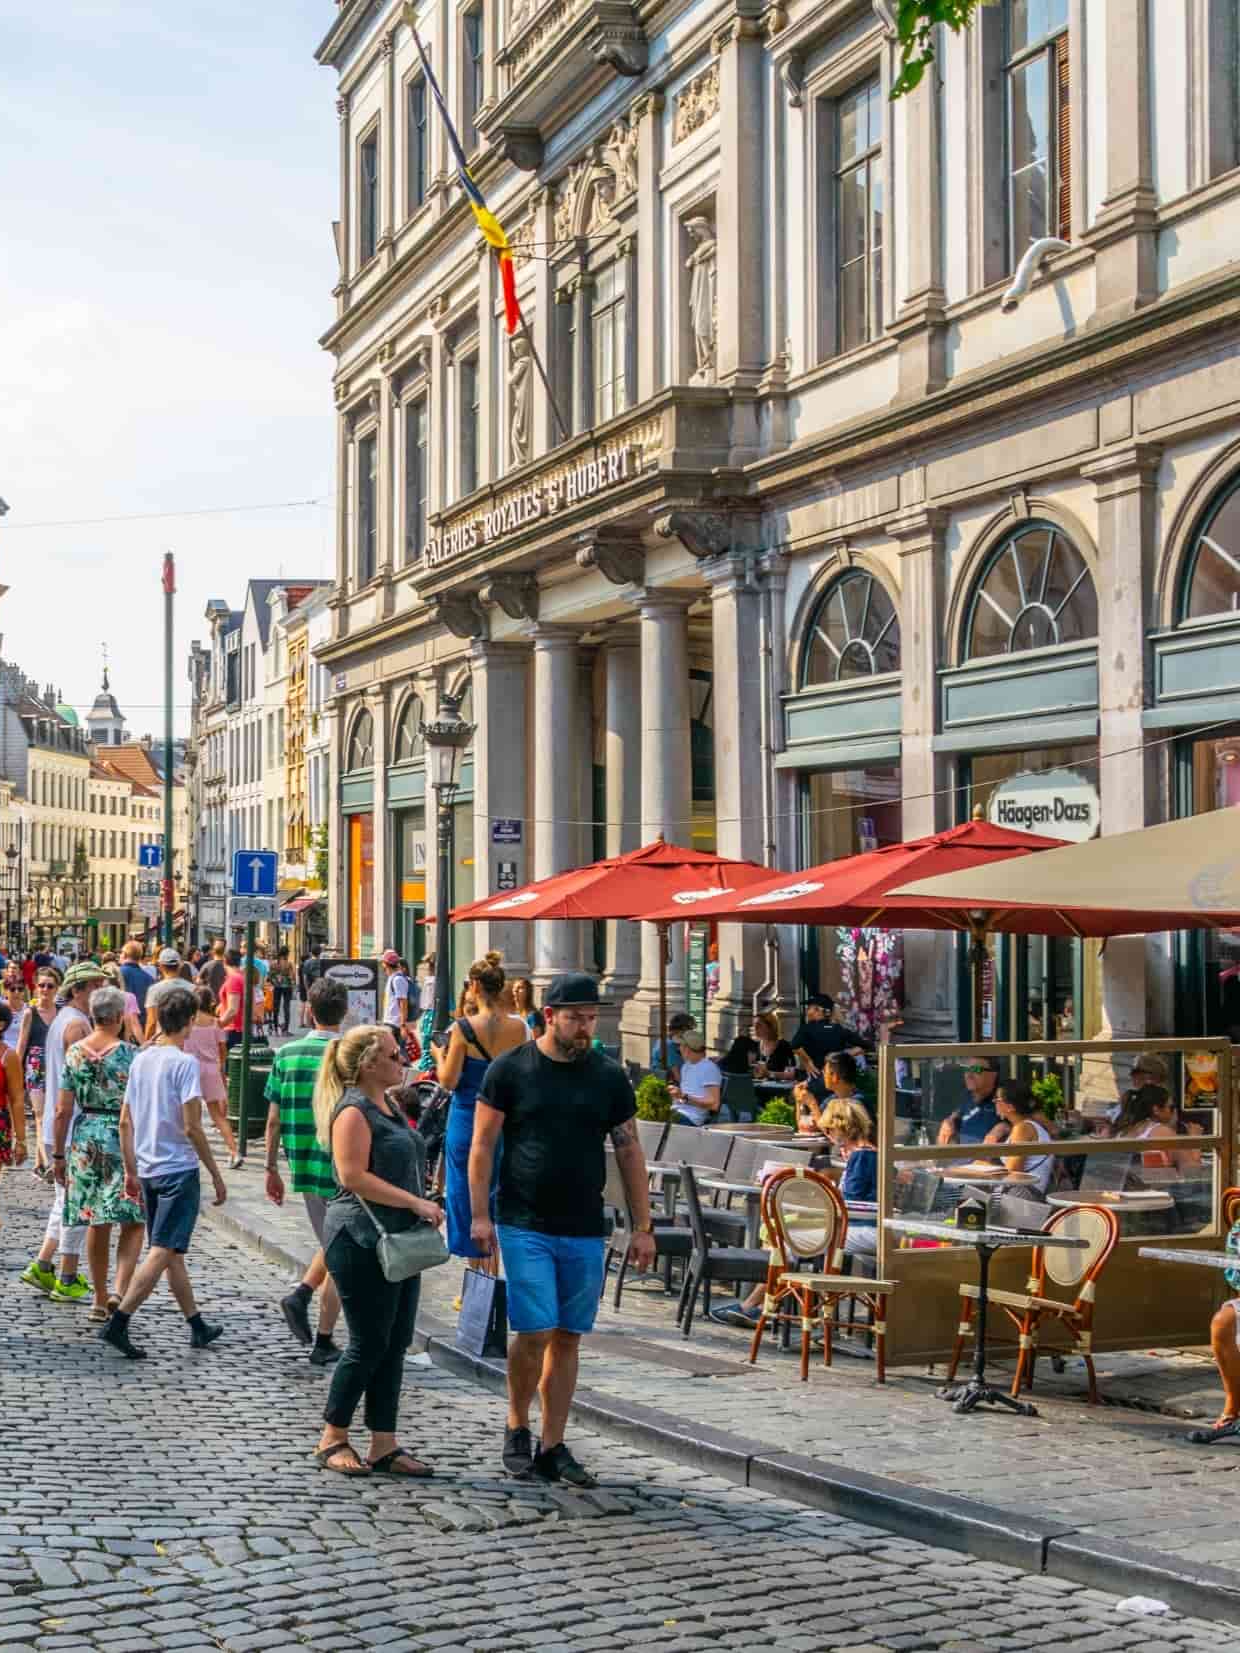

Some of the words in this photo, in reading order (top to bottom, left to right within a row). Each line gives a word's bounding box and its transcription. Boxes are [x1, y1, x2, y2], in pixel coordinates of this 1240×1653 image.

[423, 524, 477, 568] GALERIES
[484, 488, 541, 543] ROYALES
[567, 447, 630, 503] HUBERT
[998, 797, 1089, 829] Häagen-Dazs
